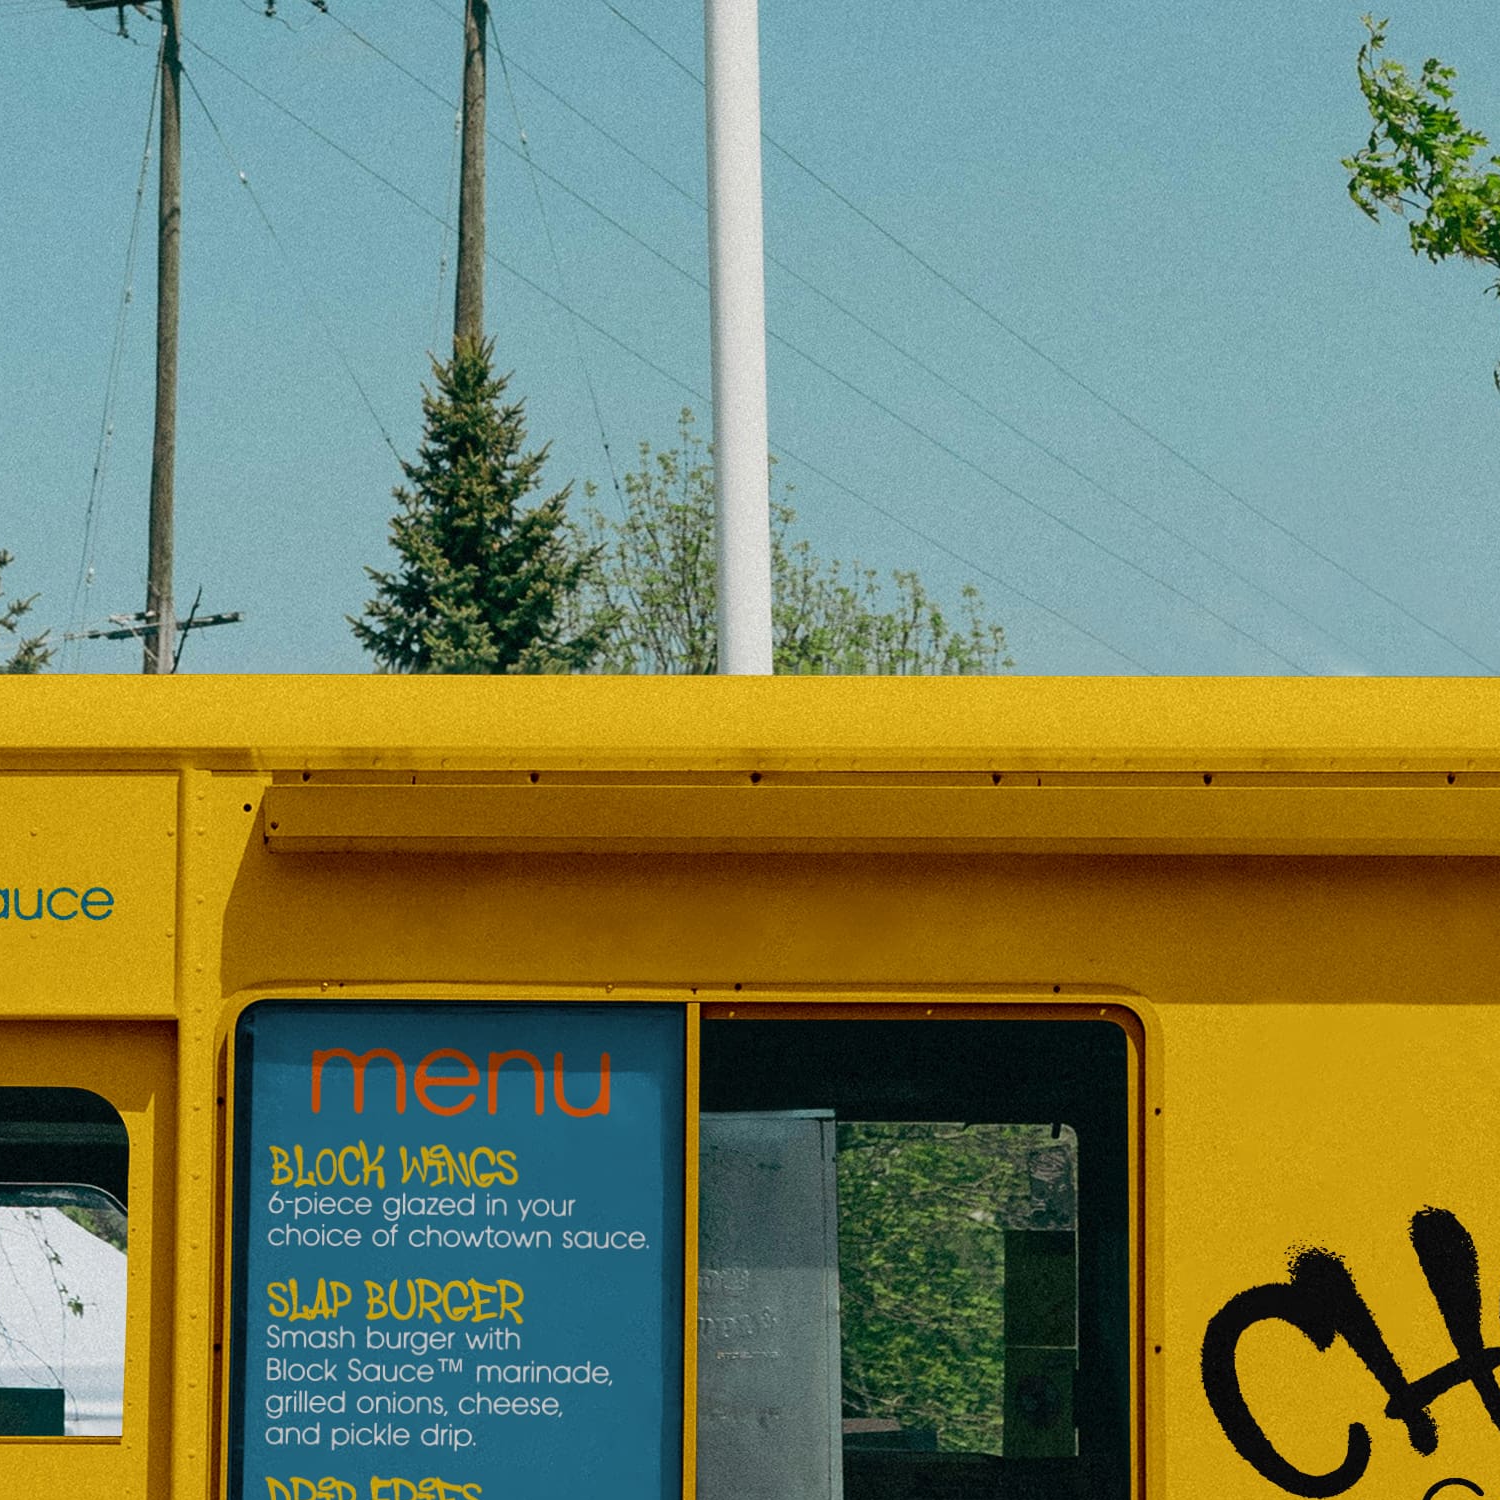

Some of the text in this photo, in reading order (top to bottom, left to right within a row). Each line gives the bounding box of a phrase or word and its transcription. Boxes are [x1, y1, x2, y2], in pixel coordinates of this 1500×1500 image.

[312, 1049, 610, 1117] menu
[270, 1141, 385, 1189] BLOCK
[269, 1191, 575, 1221] 6-piece glazed in your
[268, 1224, 650, 1249] choice of chowtown sauce.
[268, 1278, 524, 1324] SLAP BURGER
[267, 1325, 520, 1355] Smash burger with
[267, 1358, 336, 1381] Block
[477, 1361, 612, 1385] marinade,
[266, 1391, 562, 1419] grilled onions, cheese,
[265, 1423, 476, 1451] and pickle drip.
